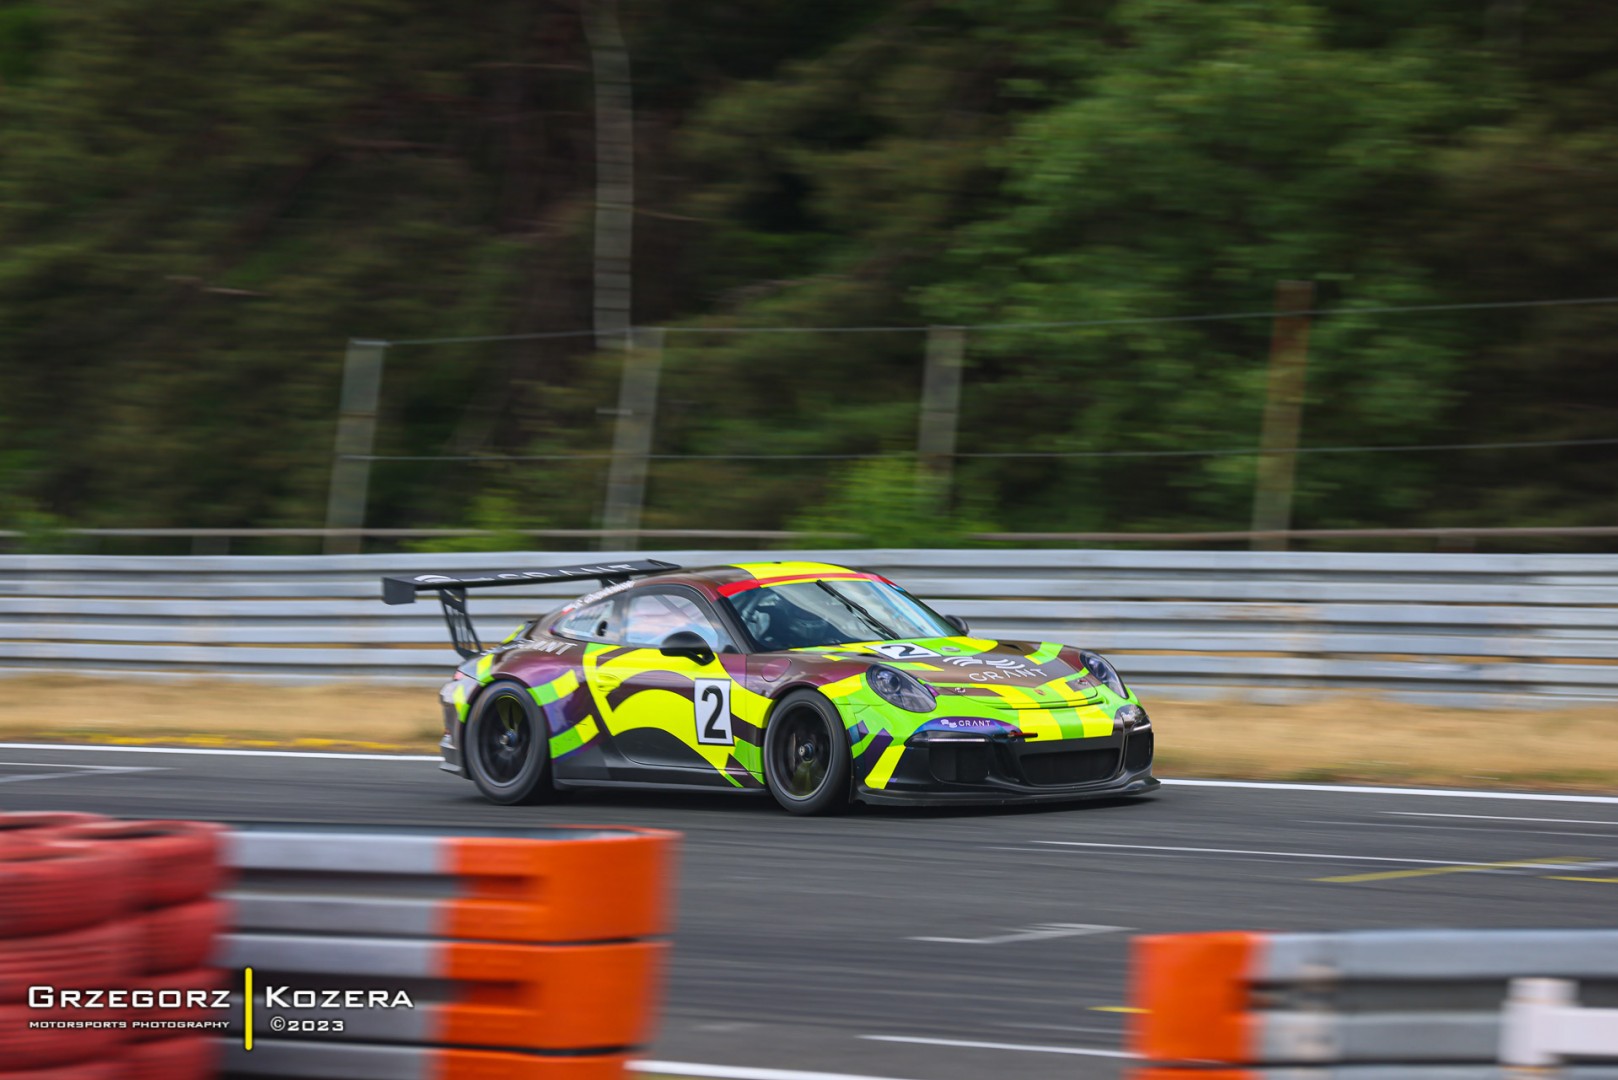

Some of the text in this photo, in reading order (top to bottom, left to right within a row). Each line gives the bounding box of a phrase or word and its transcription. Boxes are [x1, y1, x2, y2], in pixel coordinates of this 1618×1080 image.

[881, 645, 930, 657] 2
[969, 667, 1048, 683] GRANT
[701, 685, 727, 740] 2
